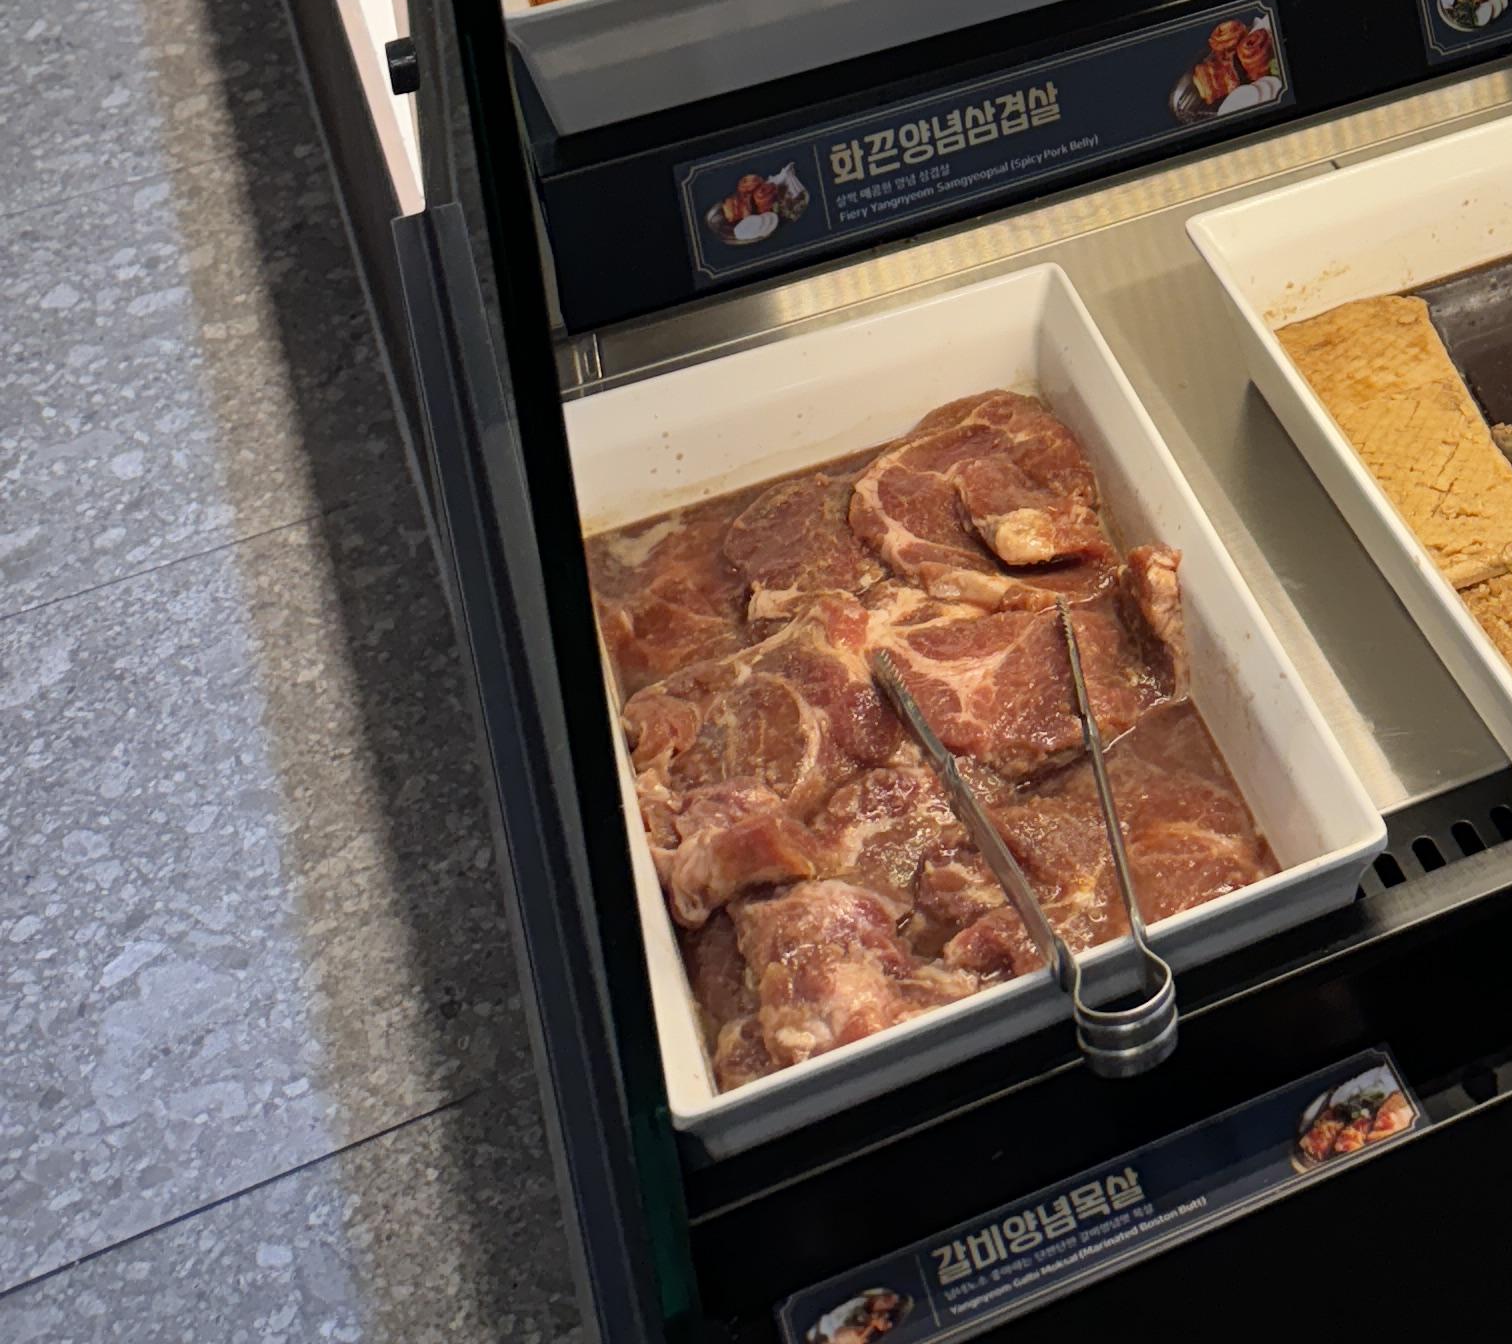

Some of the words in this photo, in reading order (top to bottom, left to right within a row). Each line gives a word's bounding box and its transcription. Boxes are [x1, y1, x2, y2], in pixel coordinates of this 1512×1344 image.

[830, 81, 1060, 184] 화끈양념삼겹살
[919, 163, 950, 183] 삼겹살
[840, 207, 868, 221] Fiery
[870, 187, 934, 212] Yangnyeom
[936, 162, 1009, 192] Samgyeopsal
[1010, 154, 1042, 170] (Spicy
[1043, 144, 1068, 159] Pork
[1069, 134, 1098, 151] Belly)
[932, 1168, 1144, 1285] 갈비양념목살
[1139, 1210, 1178, 1232] Boston
